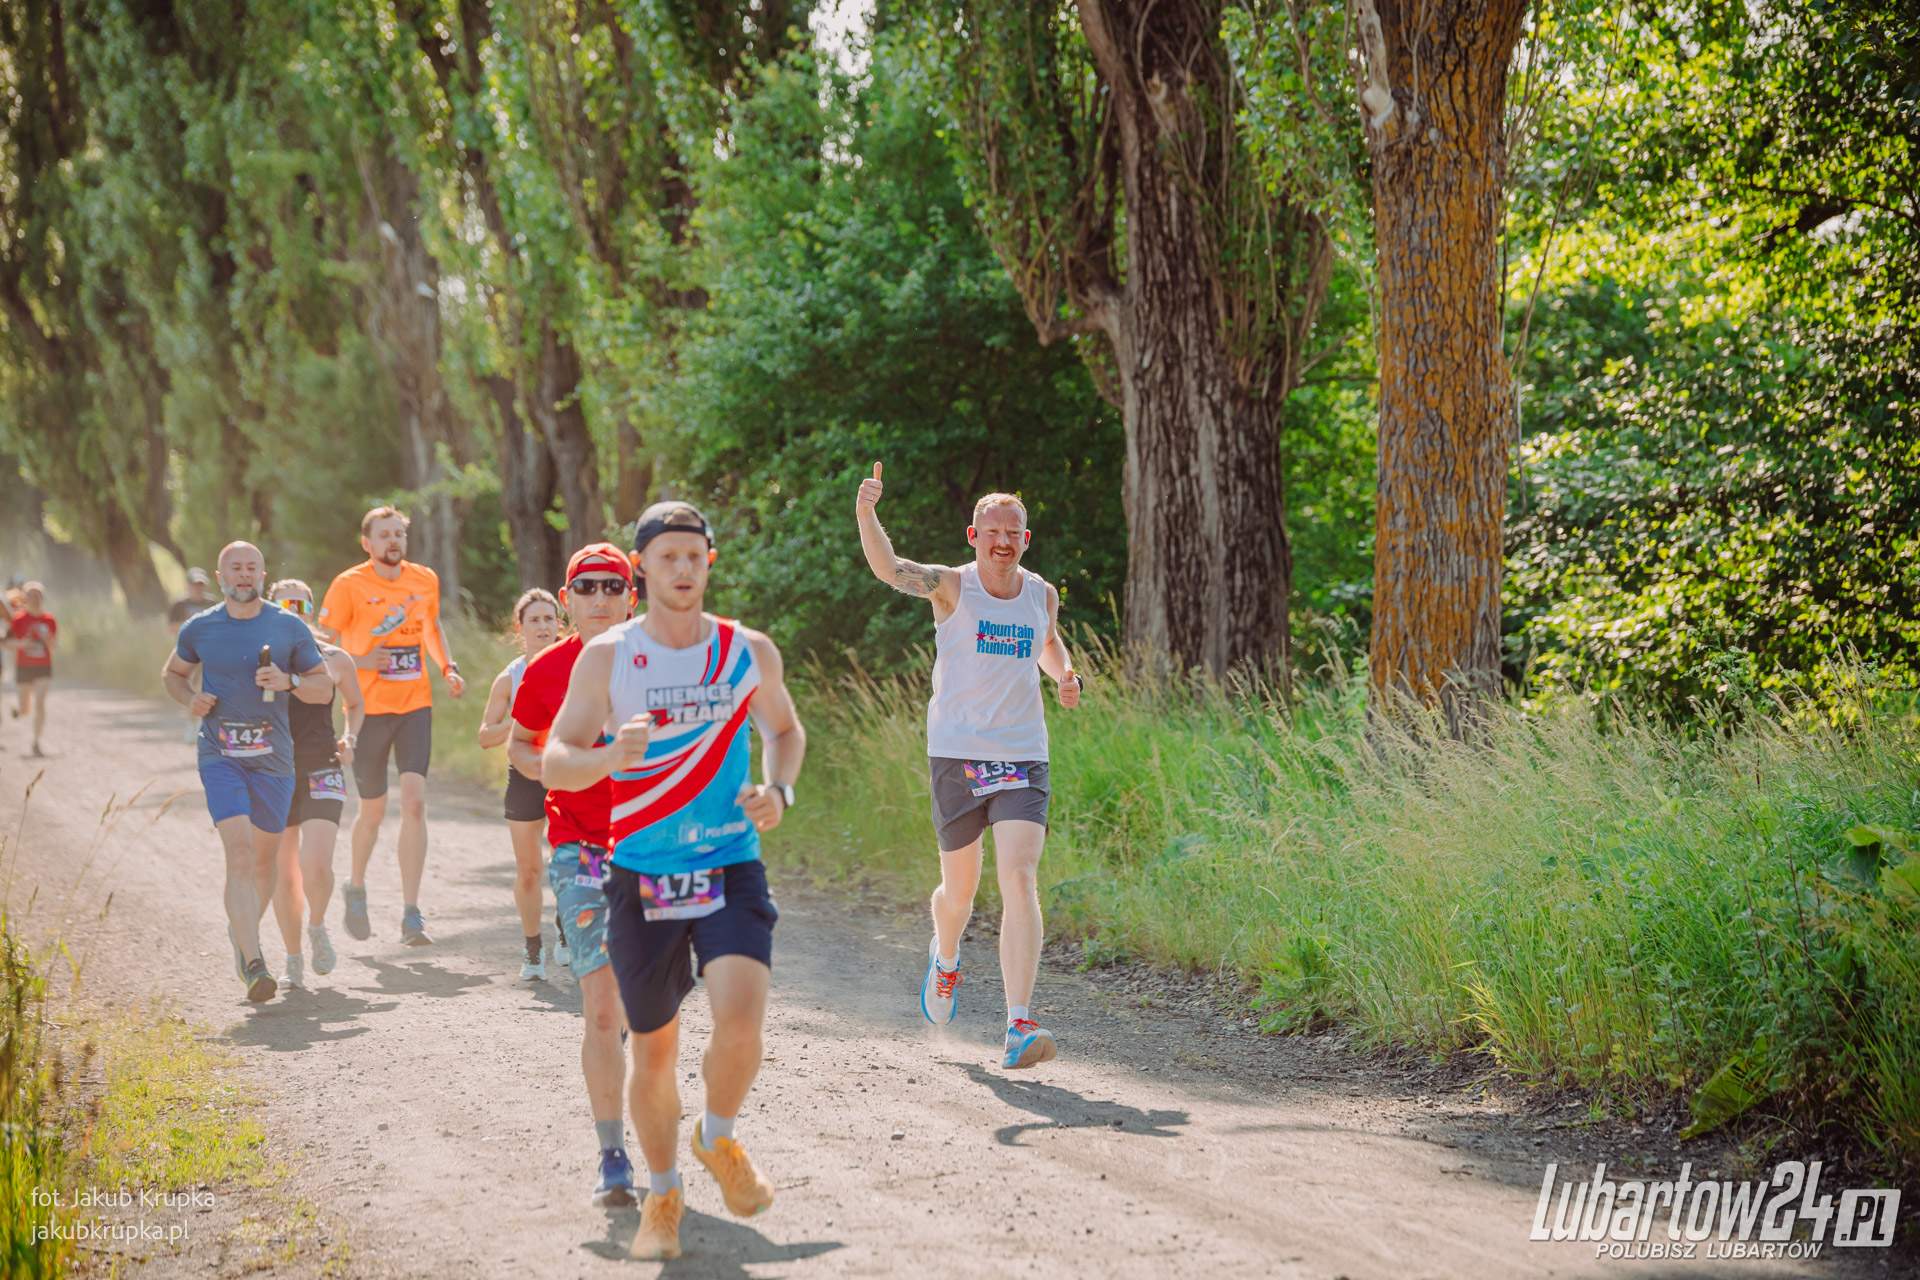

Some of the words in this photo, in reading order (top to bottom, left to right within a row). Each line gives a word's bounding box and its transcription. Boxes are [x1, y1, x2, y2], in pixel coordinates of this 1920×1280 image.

[978, 619, 1034, 641] Mountain
[390, 654, 416, 669] 145
[673, 702, 733, 723] TEAM
[228, 728, 263, 744] 142
[978, 761, 1017, 779] 135
[657, 869, 711, 899] 175
